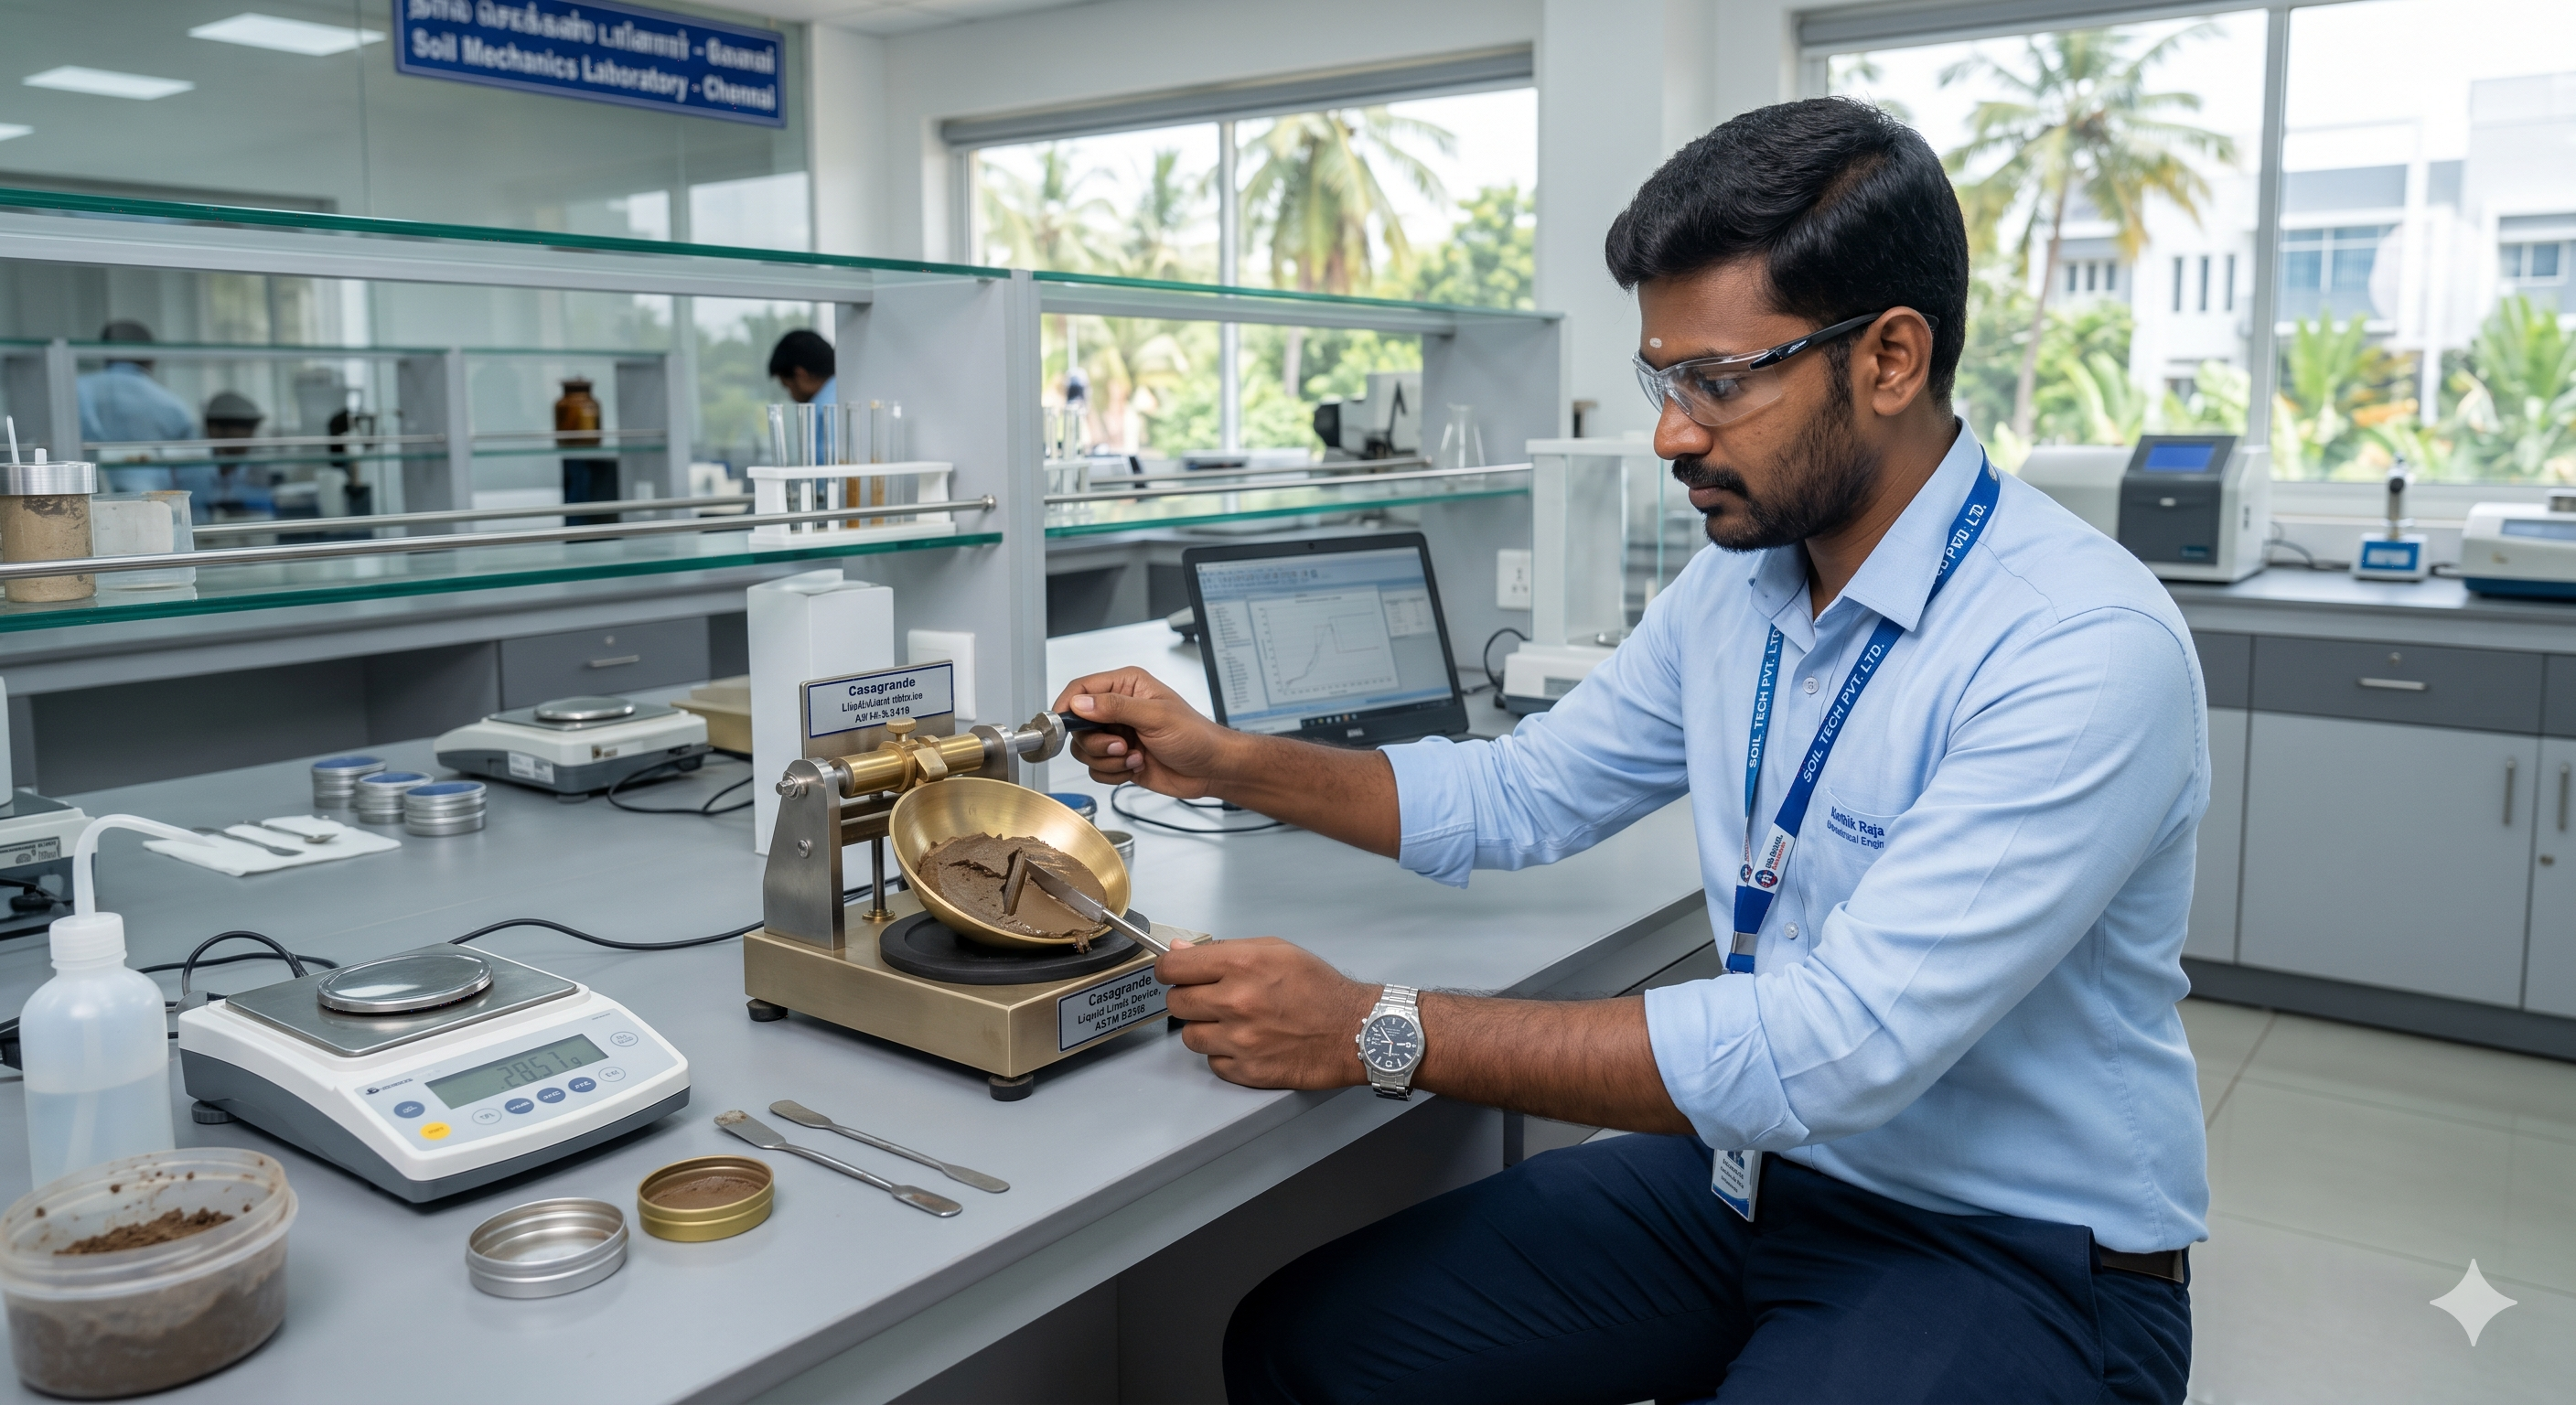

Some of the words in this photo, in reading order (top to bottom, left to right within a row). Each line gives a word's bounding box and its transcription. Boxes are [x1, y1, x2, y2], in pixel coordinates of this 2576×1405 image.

[412, 27, 457, 62] Soil
[461, 34, 579, 80] Mechanics
[582, 54, 689, 103] Laboratory
[703, 74, 777, 111] Chennai
[848, 677, 916, 696] Casagrande
[1749, 734, 1761, 768] SOIL
[1755, 692, 1768, 729] TECH
[1762, 659, 1775, 687] PVT.
[1803, 749, 1824, 783] SOIL
[1819, 704, 1845, 744] TECH
[1841, 673, 1864, 705] PVT.
[1860, 643, 1885, 673] LTD.
[1859, 820, 1885, 839] Raja
[1089, 974, 1152, 1006] Casagrande
[1131, 988, 1161, 1004] Device,
[1095, 1014, 1120, 1032] ASTM
